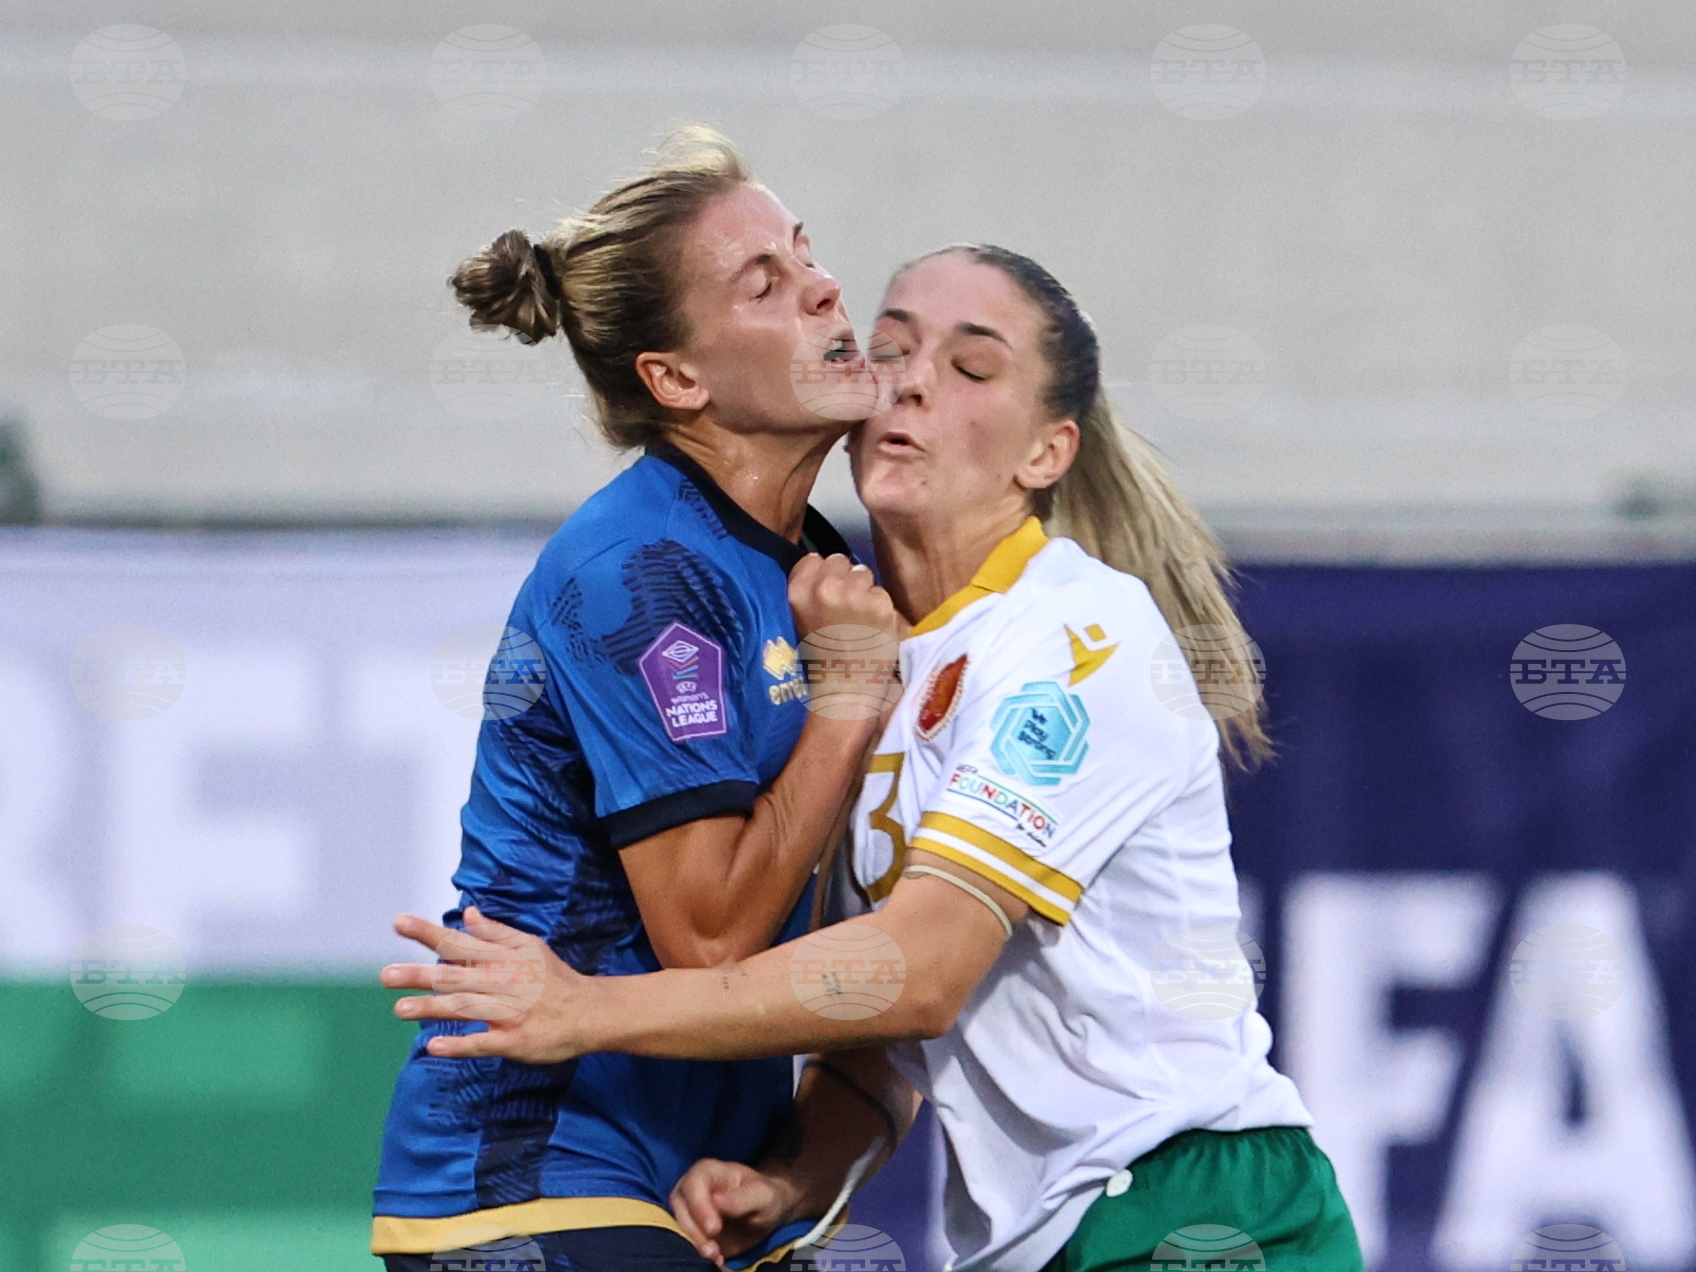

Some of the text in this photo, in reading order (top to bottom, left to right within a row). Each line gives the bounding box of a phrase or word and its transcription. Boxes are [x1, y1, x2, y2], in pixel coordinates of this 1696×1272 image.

[665, 699, 718, 718] NATIONS
[671, 711, 719, 728] LEAGUE
[948, 772, 1057, 839] FOUNDATION
